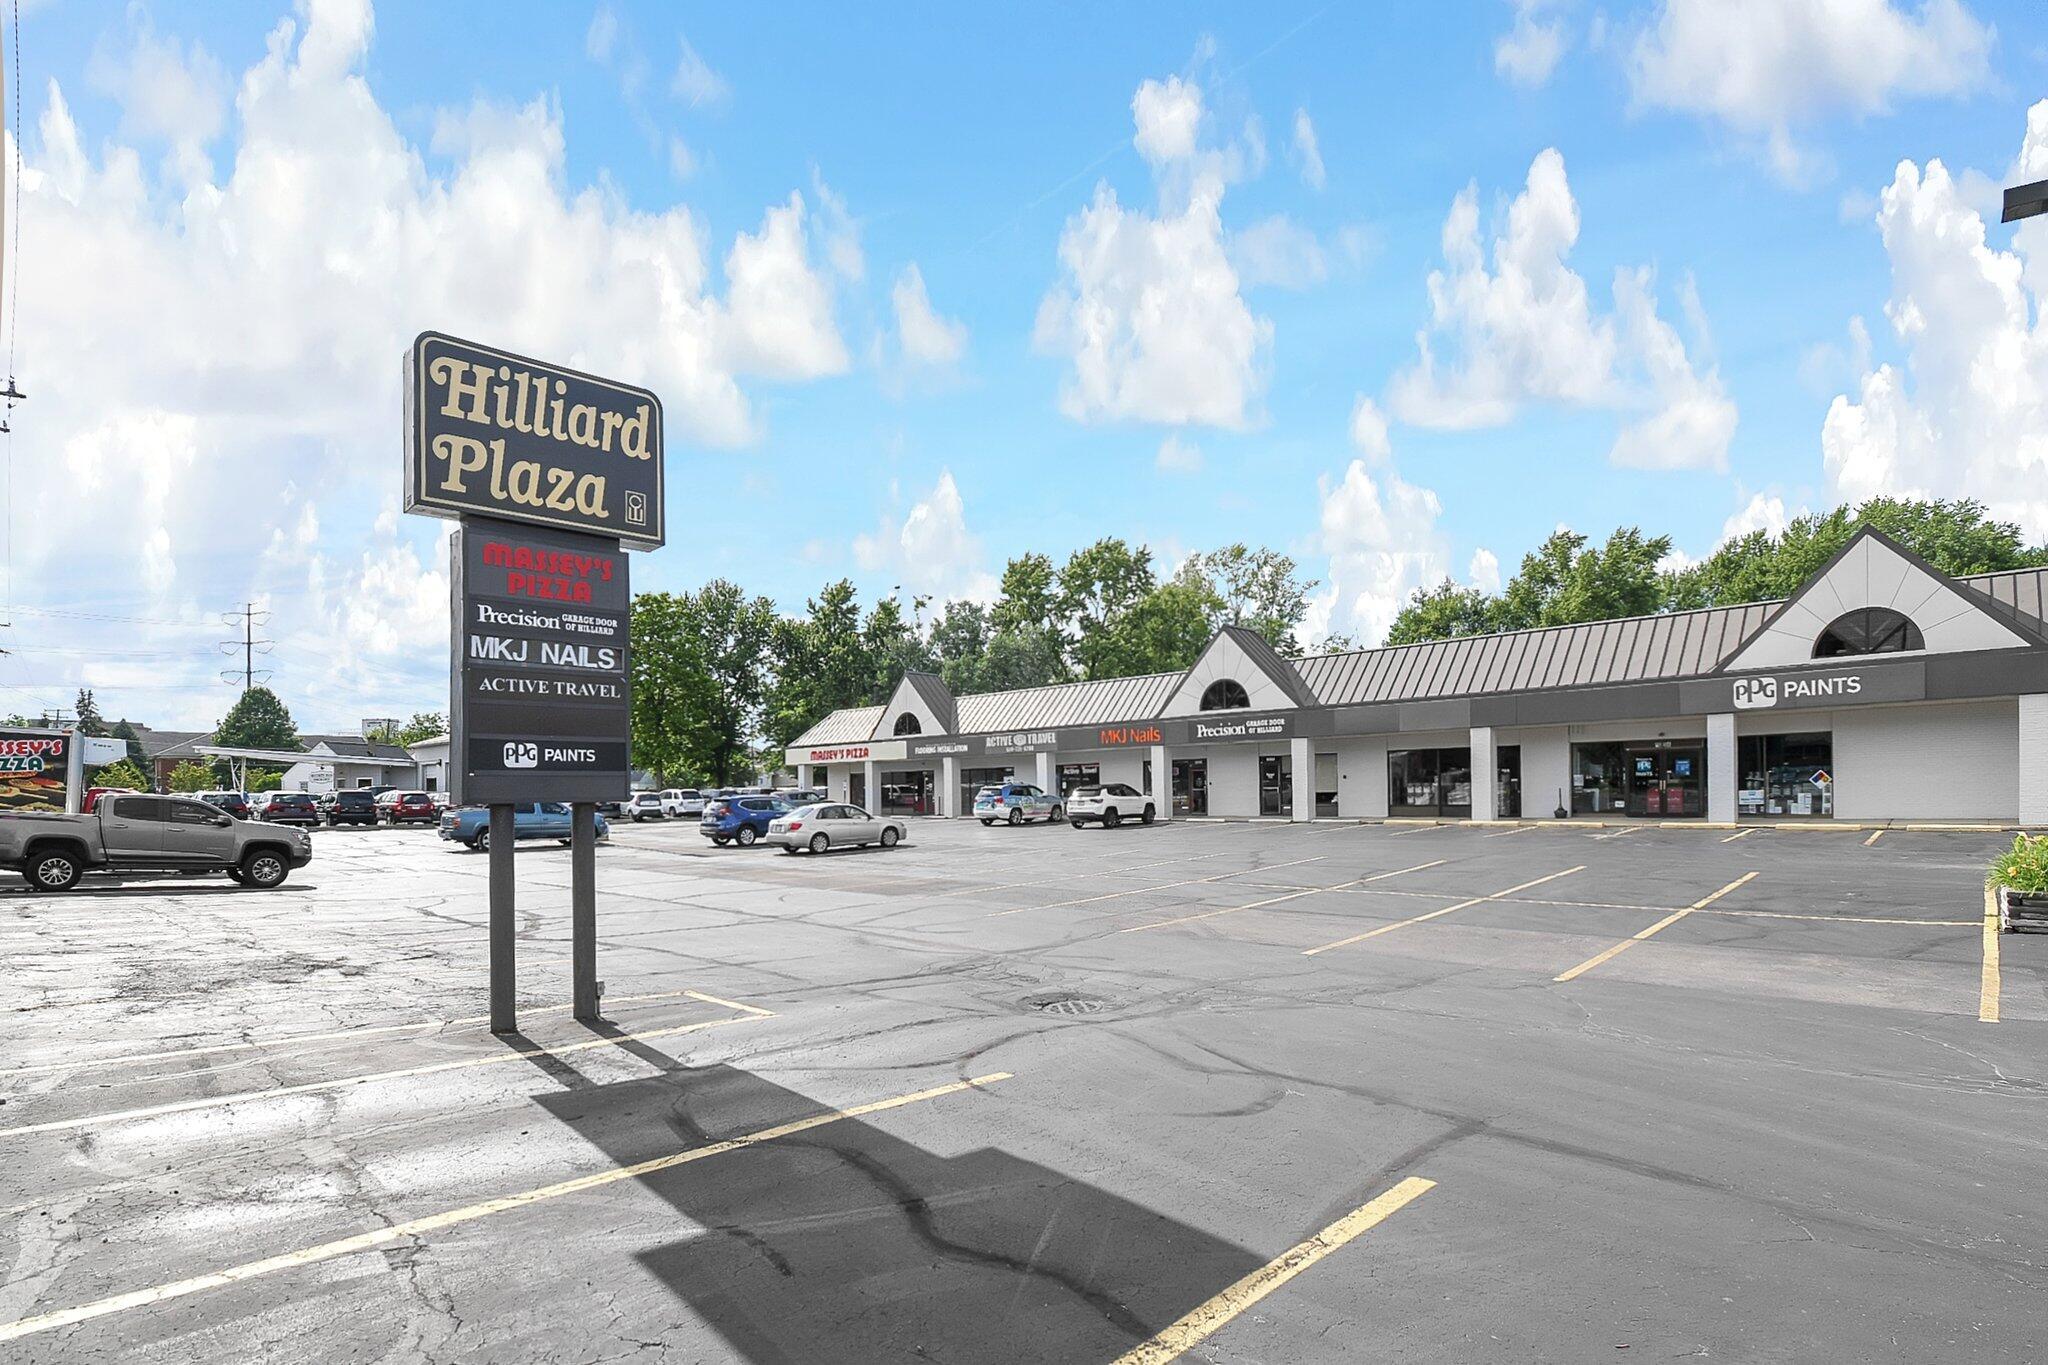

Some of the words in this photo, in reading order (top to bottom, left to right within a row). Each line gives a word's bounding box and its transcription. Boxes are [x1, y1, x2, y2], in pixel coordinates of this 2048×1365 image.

[429, 356, 651, 460] Hilliard
[432, 434, 610, 518] Plaza
[483, 542, 613, 582] MASSEY'S
[508, 573, 591, 604] PIZZA
[477, 604, 561, 630] Precision
[562, 613, 595, 625] GARAGE
[595, 617, 618, 628] DOOR
[565, 623, 576, 631] OF
[577, 624, 614, 635] HILLIARD
[470, 634, 527, 662] MKJ
[541, 642, 615, 670] NAILS
[479, 677, 549, 695] ACTIVE
[553, 681, 621, 698] TRAVEL
[1735, 678, 1776, 706] PPG
[1784, 676, 1861, 698] PAINTS
[986, 735, 1013, 747] ACTIVE
[1027, 732, 1056, 744] TRAVEL
[1101, 728, 1127, 744] MKJ
[1130, 726, 1161, 743] Nails
[1196, 722, 1245, 738] Precision
[504, 742, 537, 767] PPG
[544, 748, 596, 762] PAINTS
[810, 749, 845, 761] MASSEY'S
[846, 747, 869, 759] PIZZA
